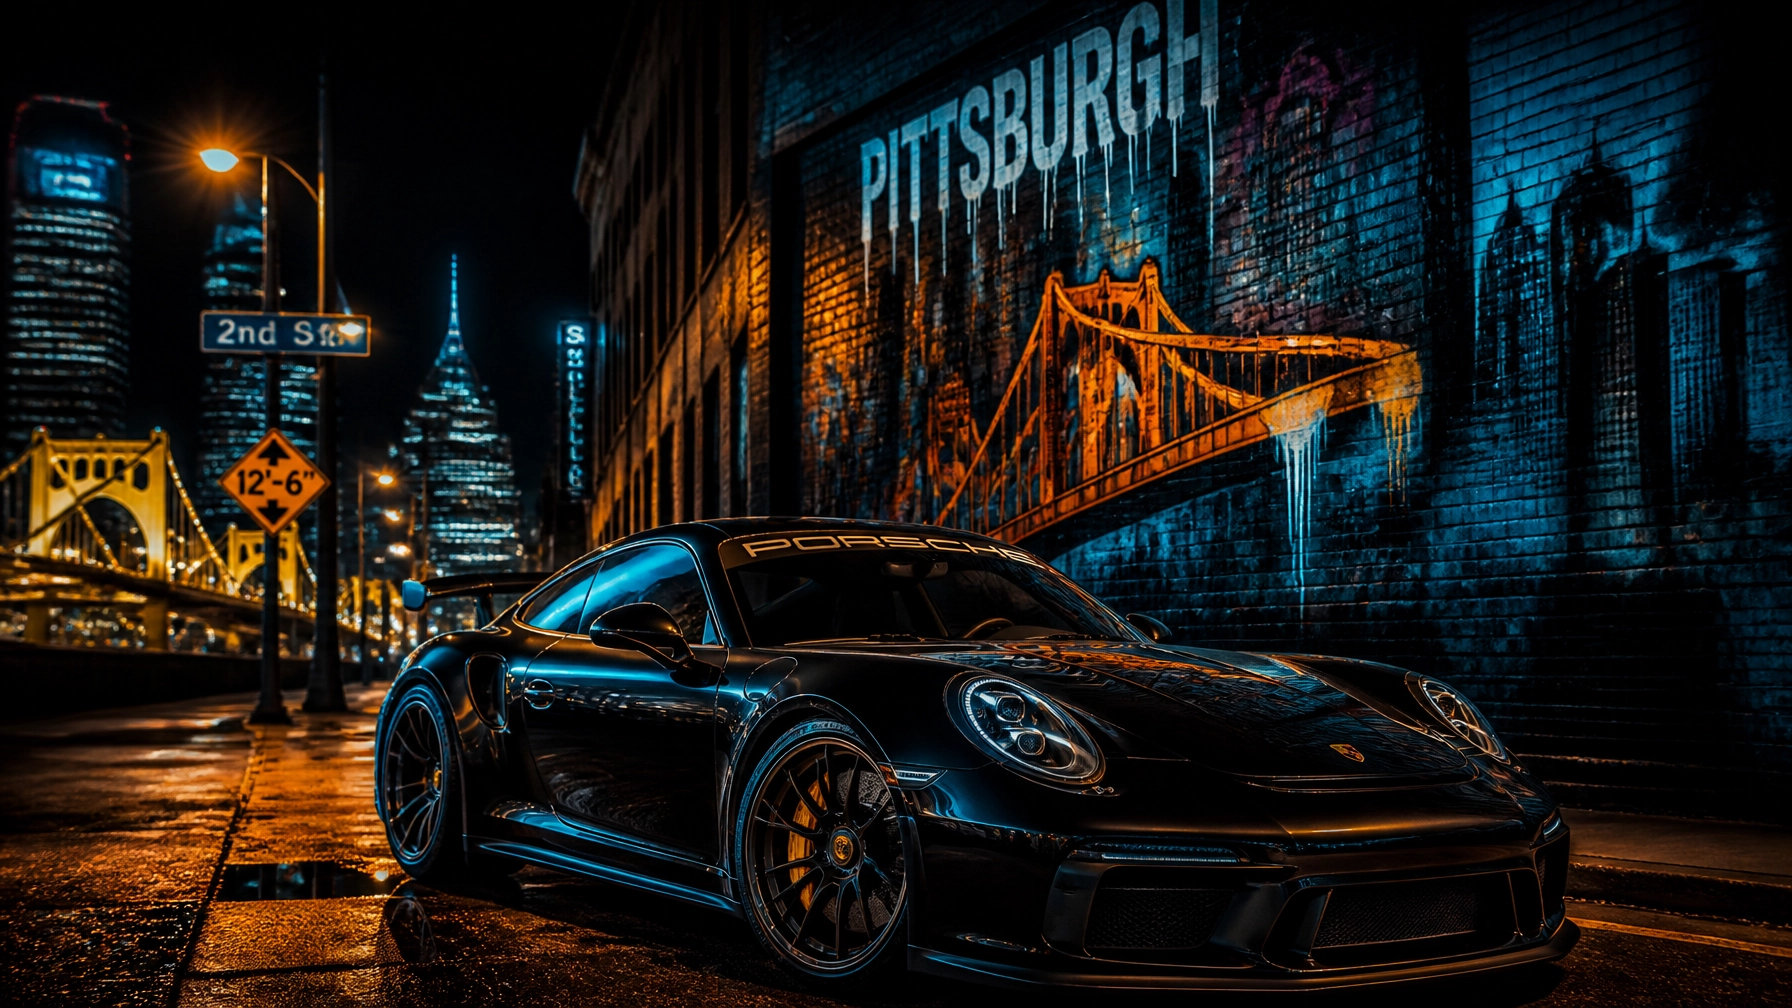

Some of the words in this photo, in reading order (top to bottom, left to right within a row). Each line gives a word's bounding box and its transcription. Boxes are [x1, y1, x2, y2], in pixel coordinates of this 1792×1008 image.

[860, 0, 1220, 243] PITTSBURGH
[216, 318, 277, 346] 2nd
[742, 535, 1045, 570] PORSCHE
